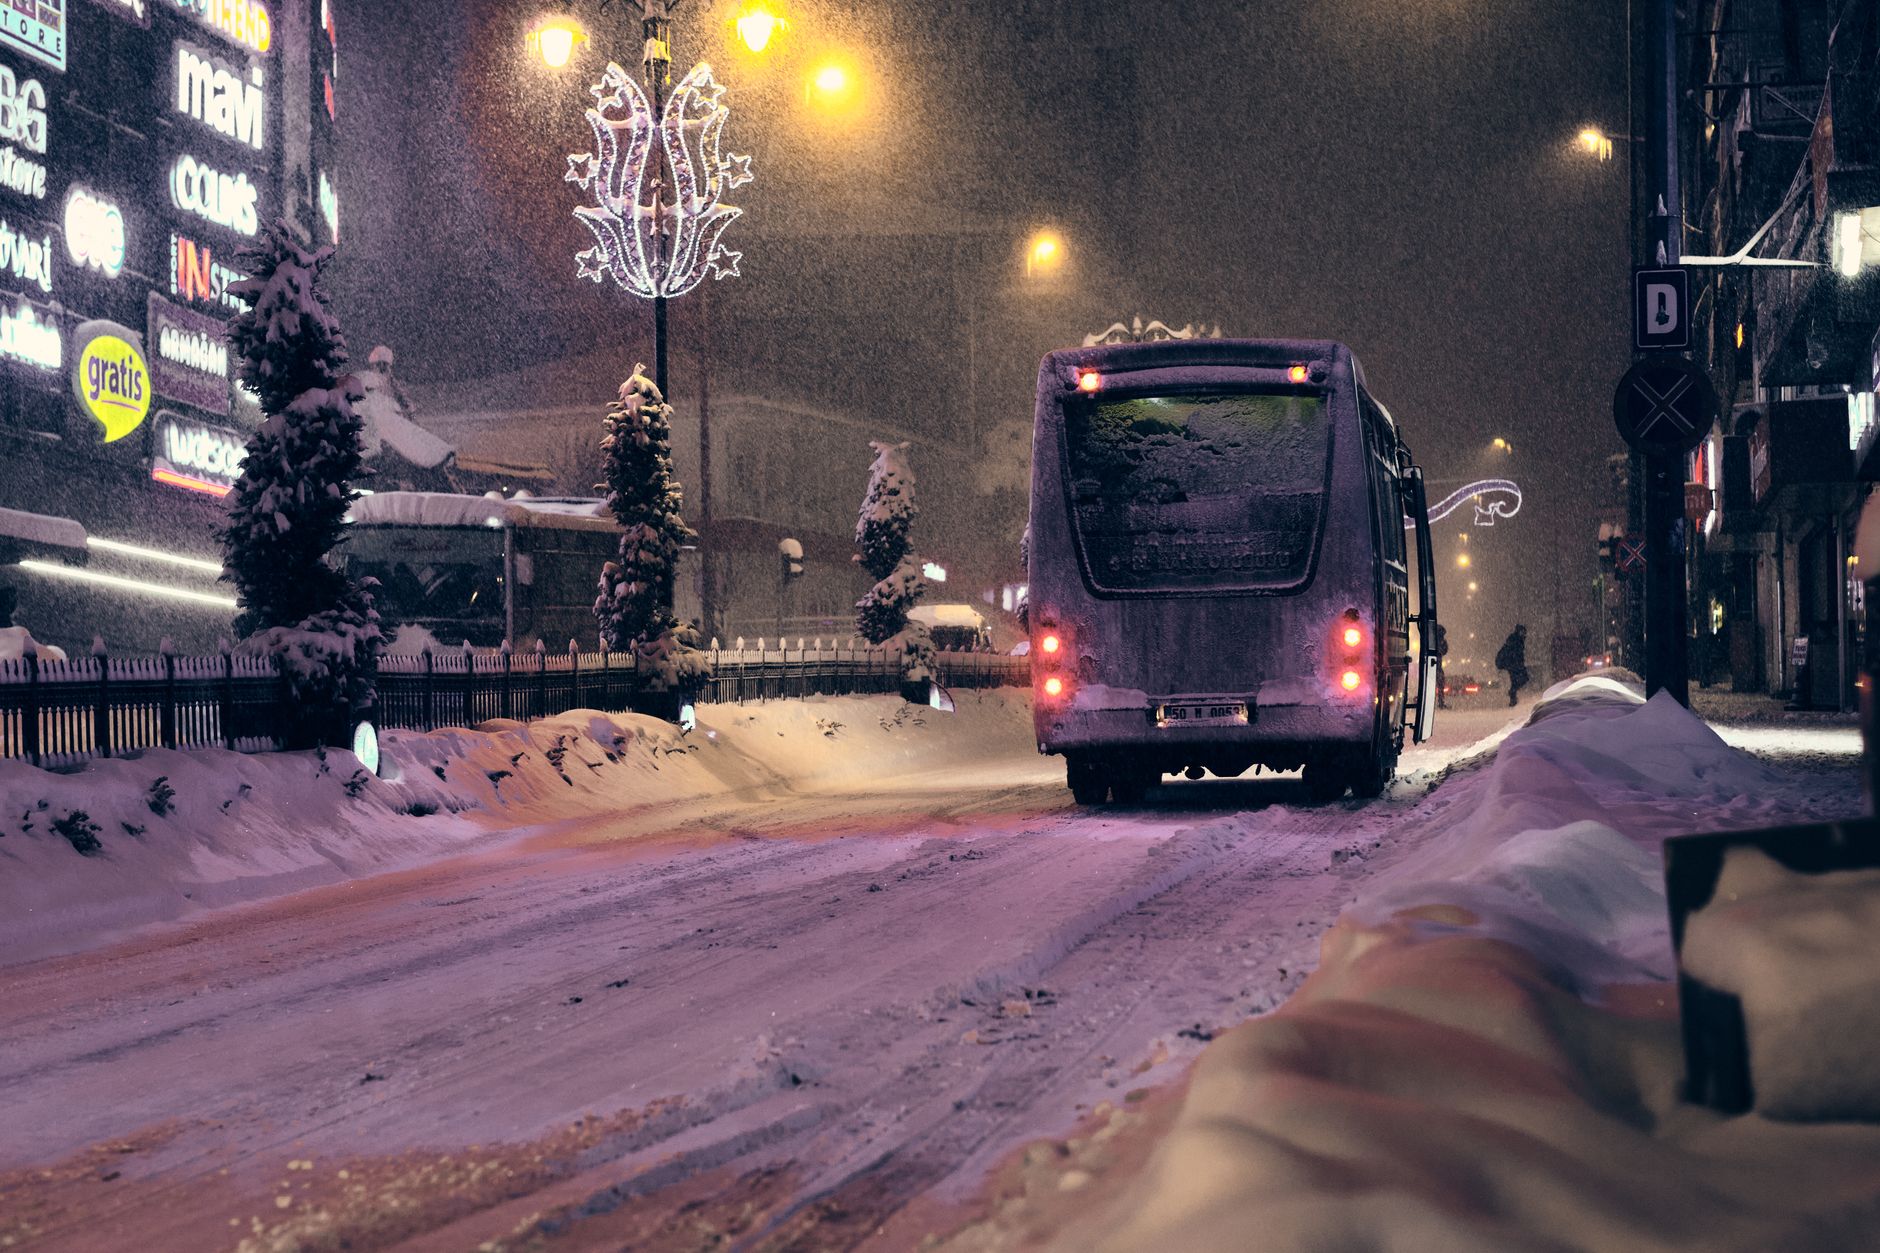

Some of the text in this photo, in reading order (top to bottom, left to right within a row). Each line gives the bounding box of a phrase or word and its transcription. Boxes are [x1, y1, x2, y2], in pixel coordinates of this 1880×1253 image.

[179, 49, 262, 149] mavi
[1646, 283, 1677, 334] D
[87, 355, 142, 401] gratis
[1172, 708, 1186, 720] 50
